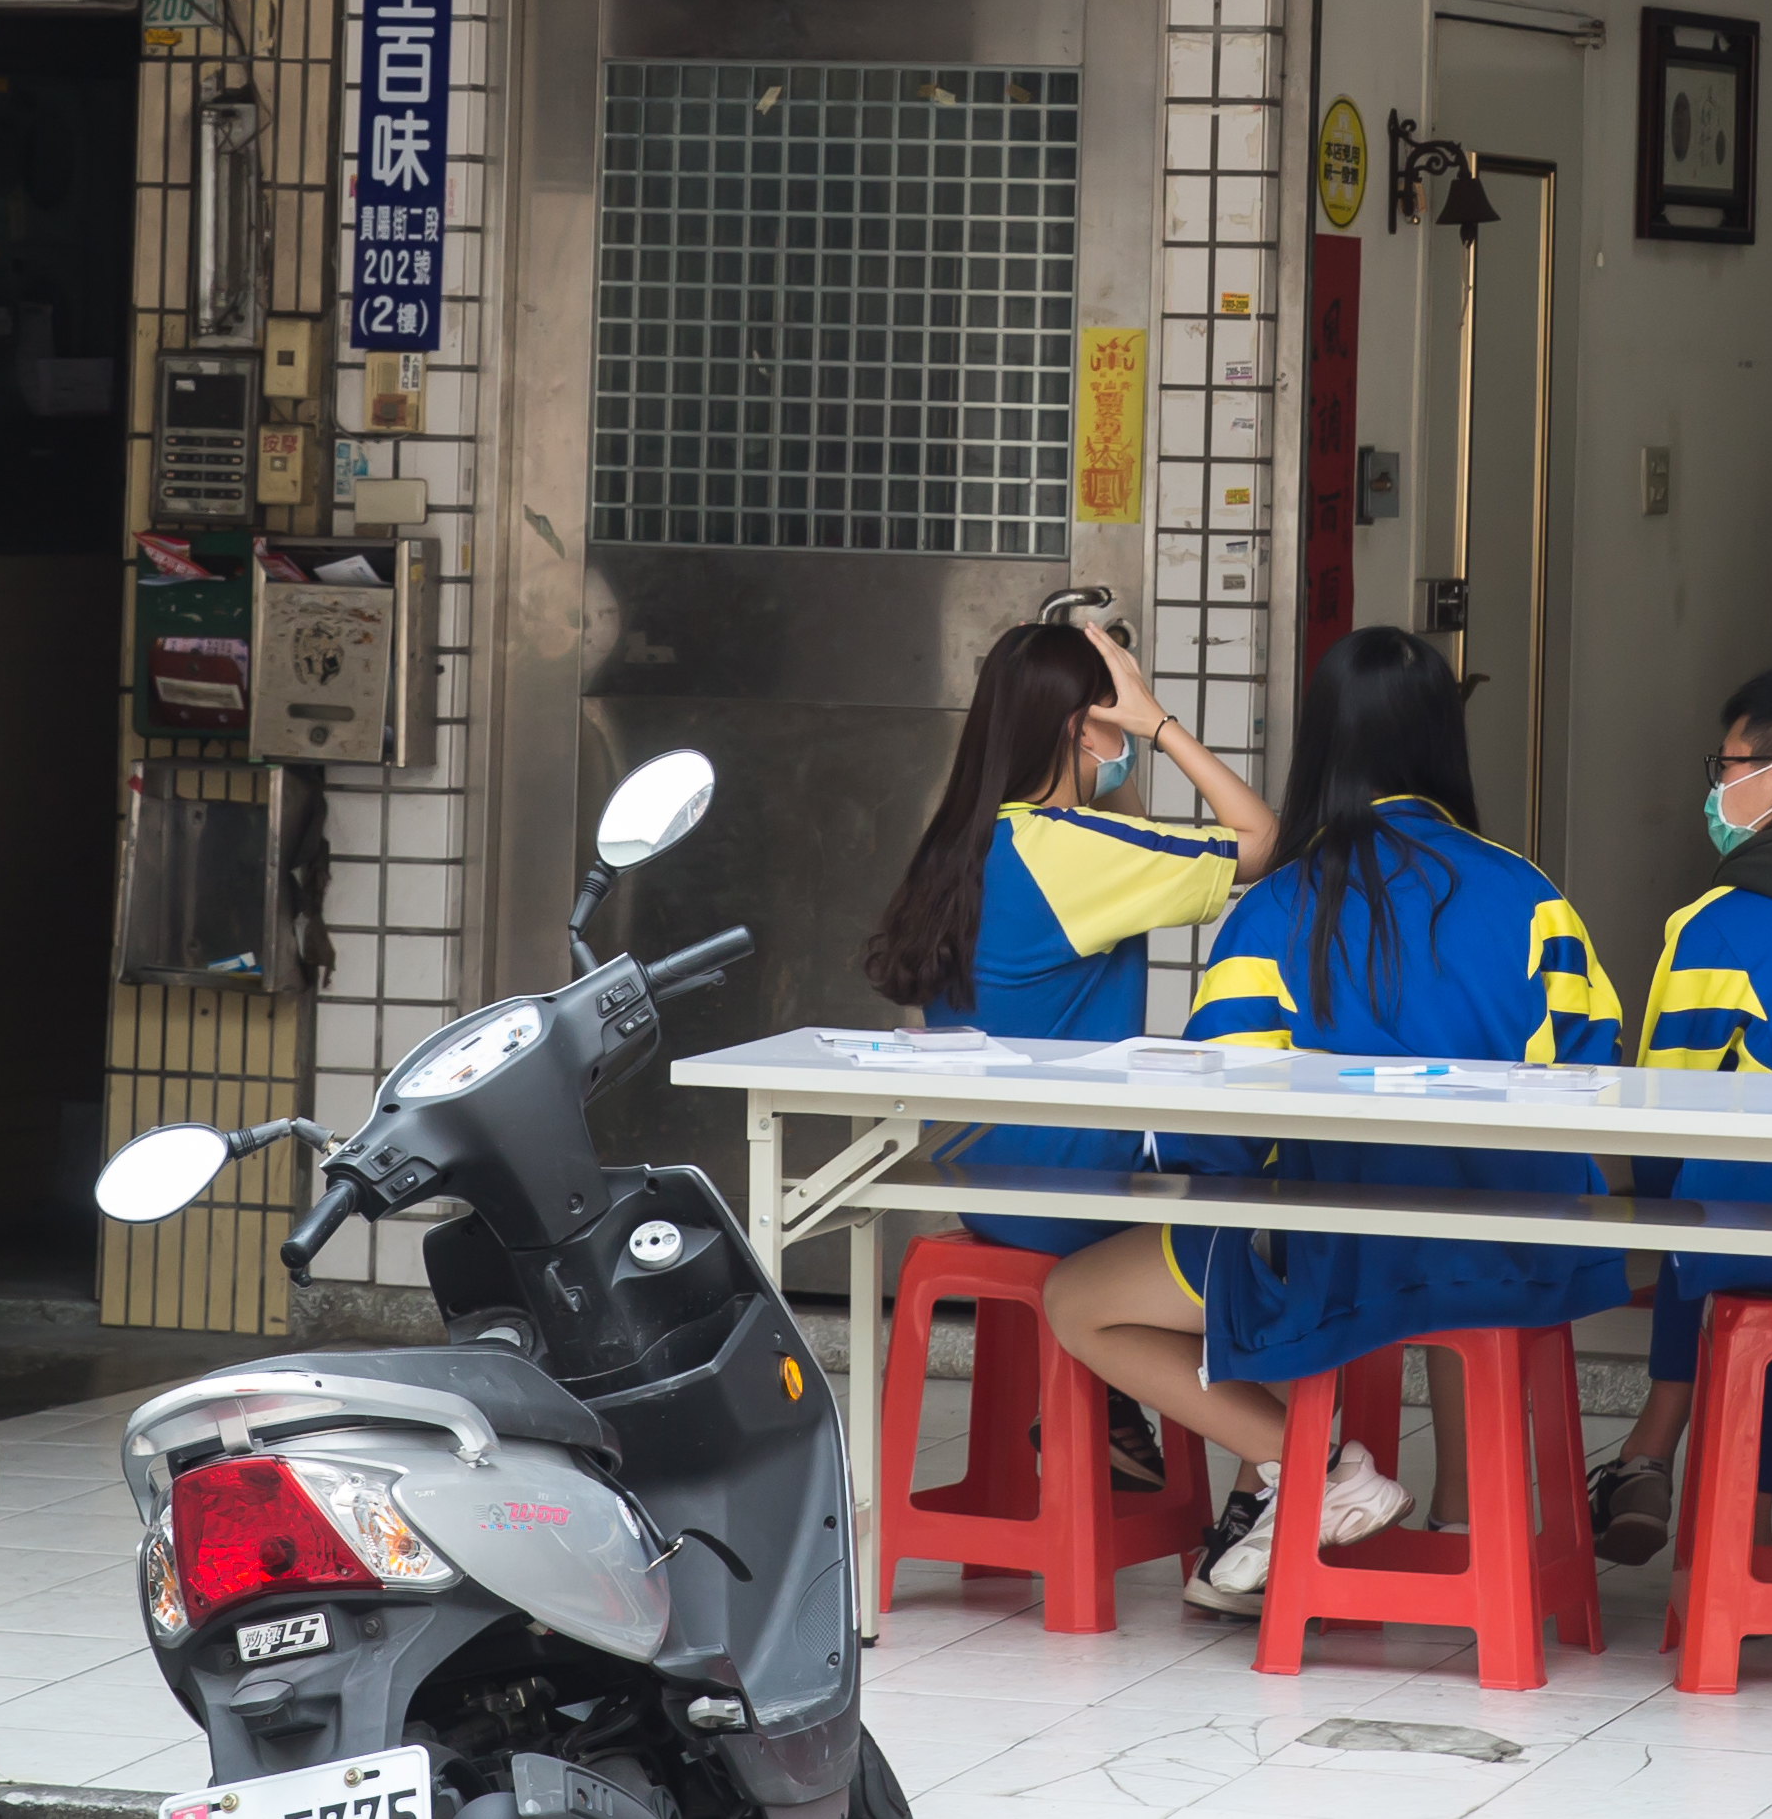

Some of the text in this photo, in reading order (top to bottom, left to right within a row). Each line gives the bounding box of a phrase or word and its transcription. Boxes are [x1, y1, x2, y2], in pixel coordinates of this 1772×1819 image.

[361, 206, 440, 243] 貴陽街二段
[365, 249, 431, 287] 202號
[360, 295, 429, 337] (2樓)
